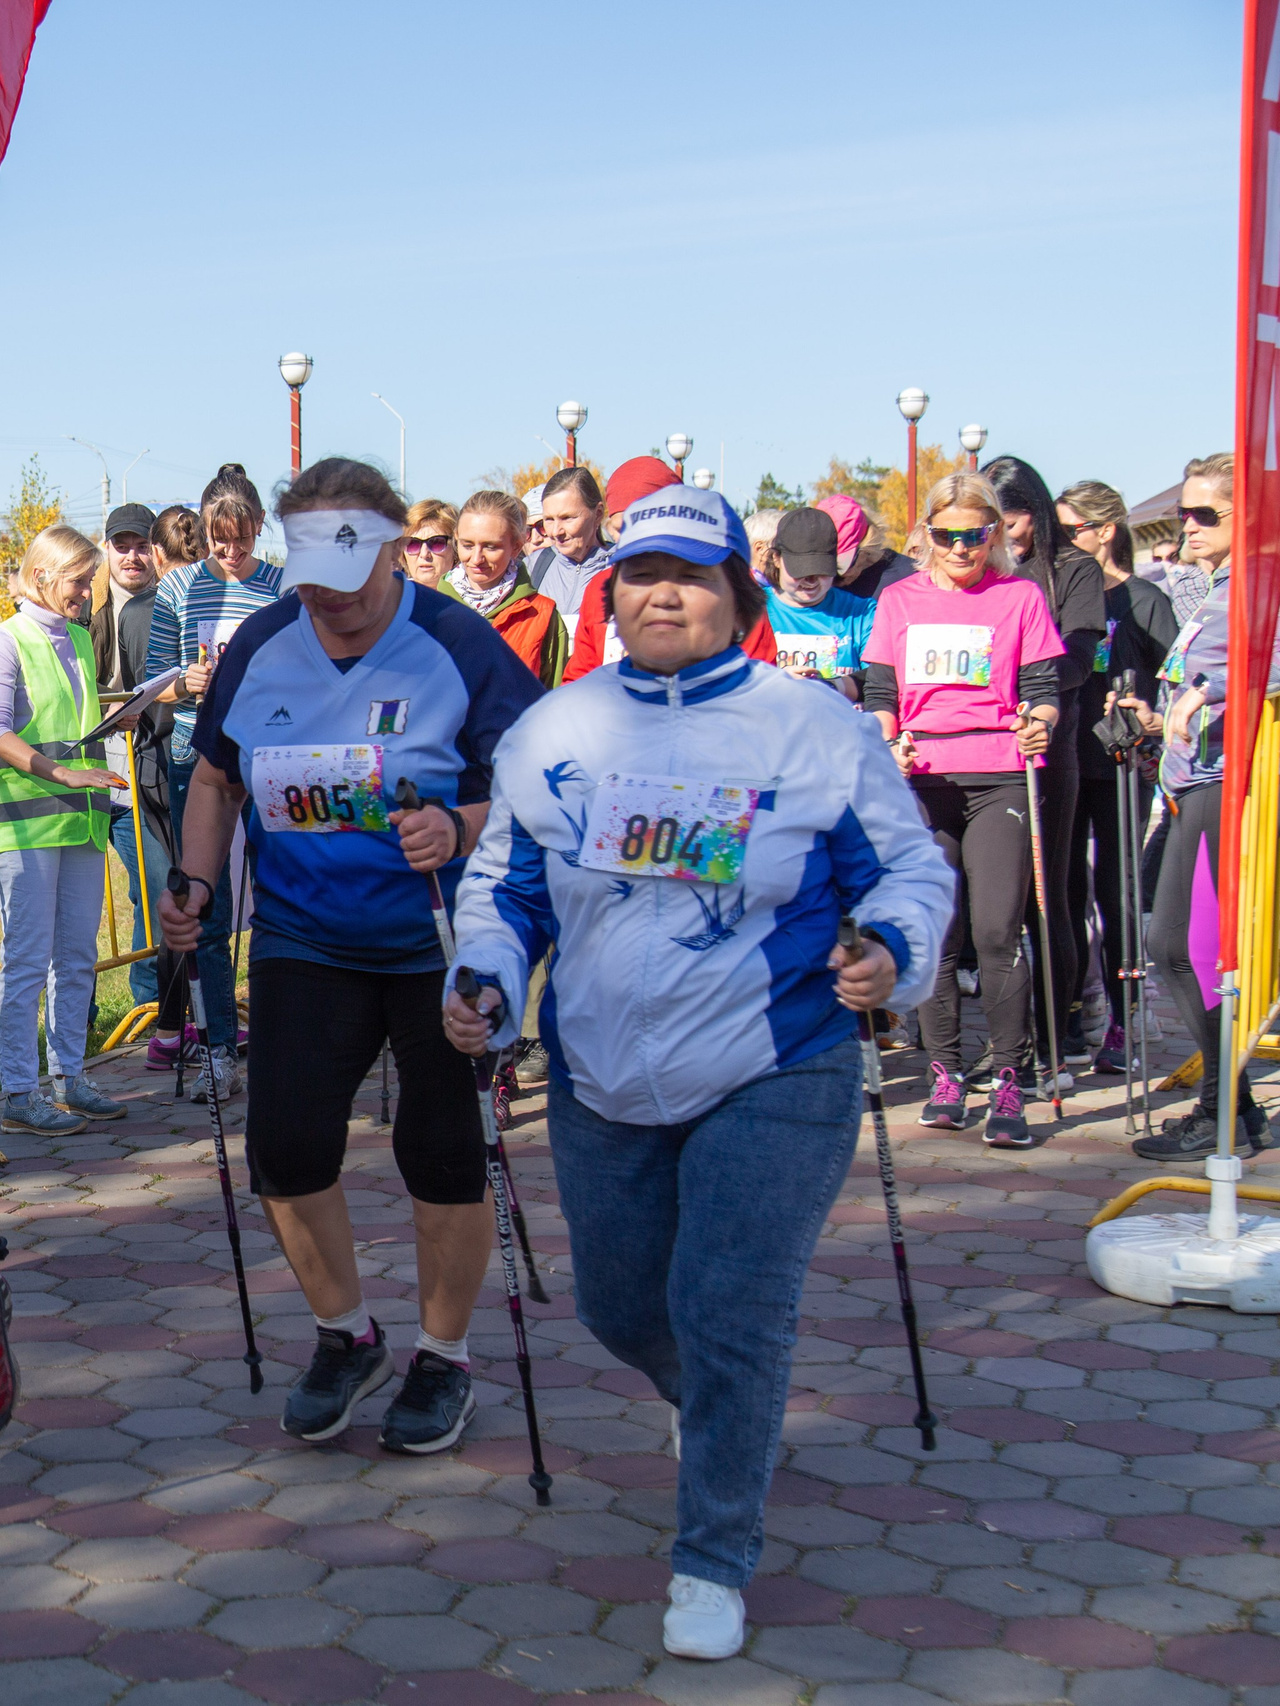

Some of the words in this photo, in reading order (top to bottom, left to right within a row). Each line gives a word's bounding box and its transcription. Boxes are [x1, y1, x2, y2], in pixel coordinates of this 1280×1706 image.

[629, 505, 718, 526] ШЕРБАКУЛЬ
[925, 649, 971, 677] 810
[284, 785, 355, 823] 805
[621, 814, 704, 867] 804
[488, 1161, 510, 1235] СЕВЕРНАЯ
